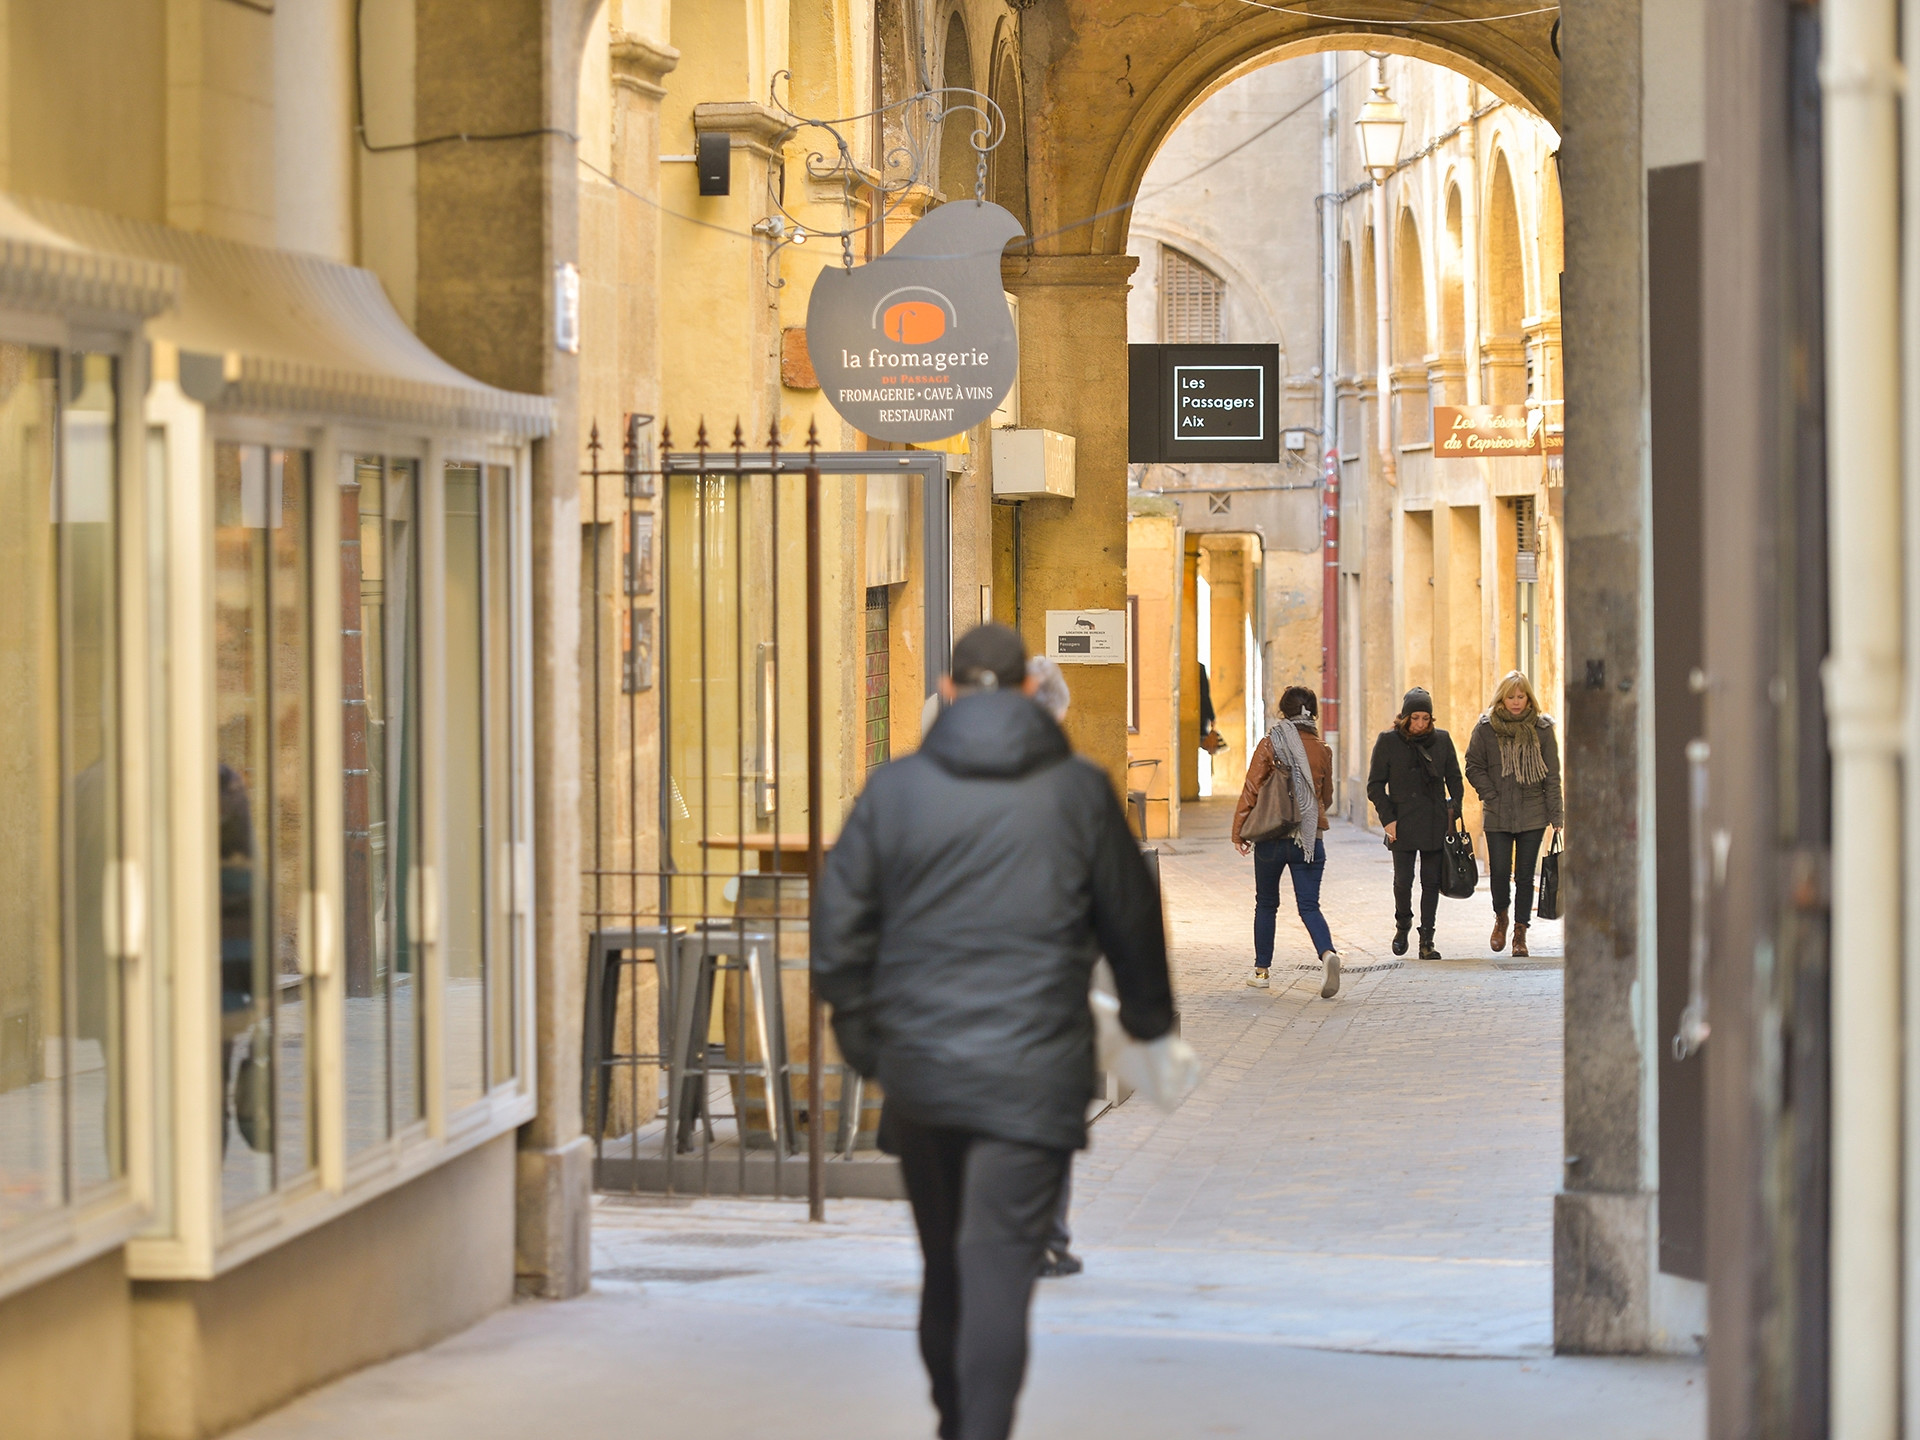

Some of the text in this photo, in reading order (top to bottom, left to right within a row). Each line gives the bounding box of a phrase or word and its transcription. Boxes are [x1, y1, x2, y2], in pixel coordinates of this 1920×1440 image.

[842, 348, 989, 371] la fromagerie
[901, 374, 950, 384] PASSAGE
[1182, 377, 1205, 389] Les
[839, 384, 993, 402] FROMAGERIE CAVE À VINS
[1182, 396, 1255, 411] Passagers
[879, 408, 954, 422] RESTAURANT
[1182, 415, 1205, 427] Aix
[1453, 414, 1475, 429] Les
[1444, 433, 1462, 449] du
[1467, 434, 1535, 452] Capricorne
